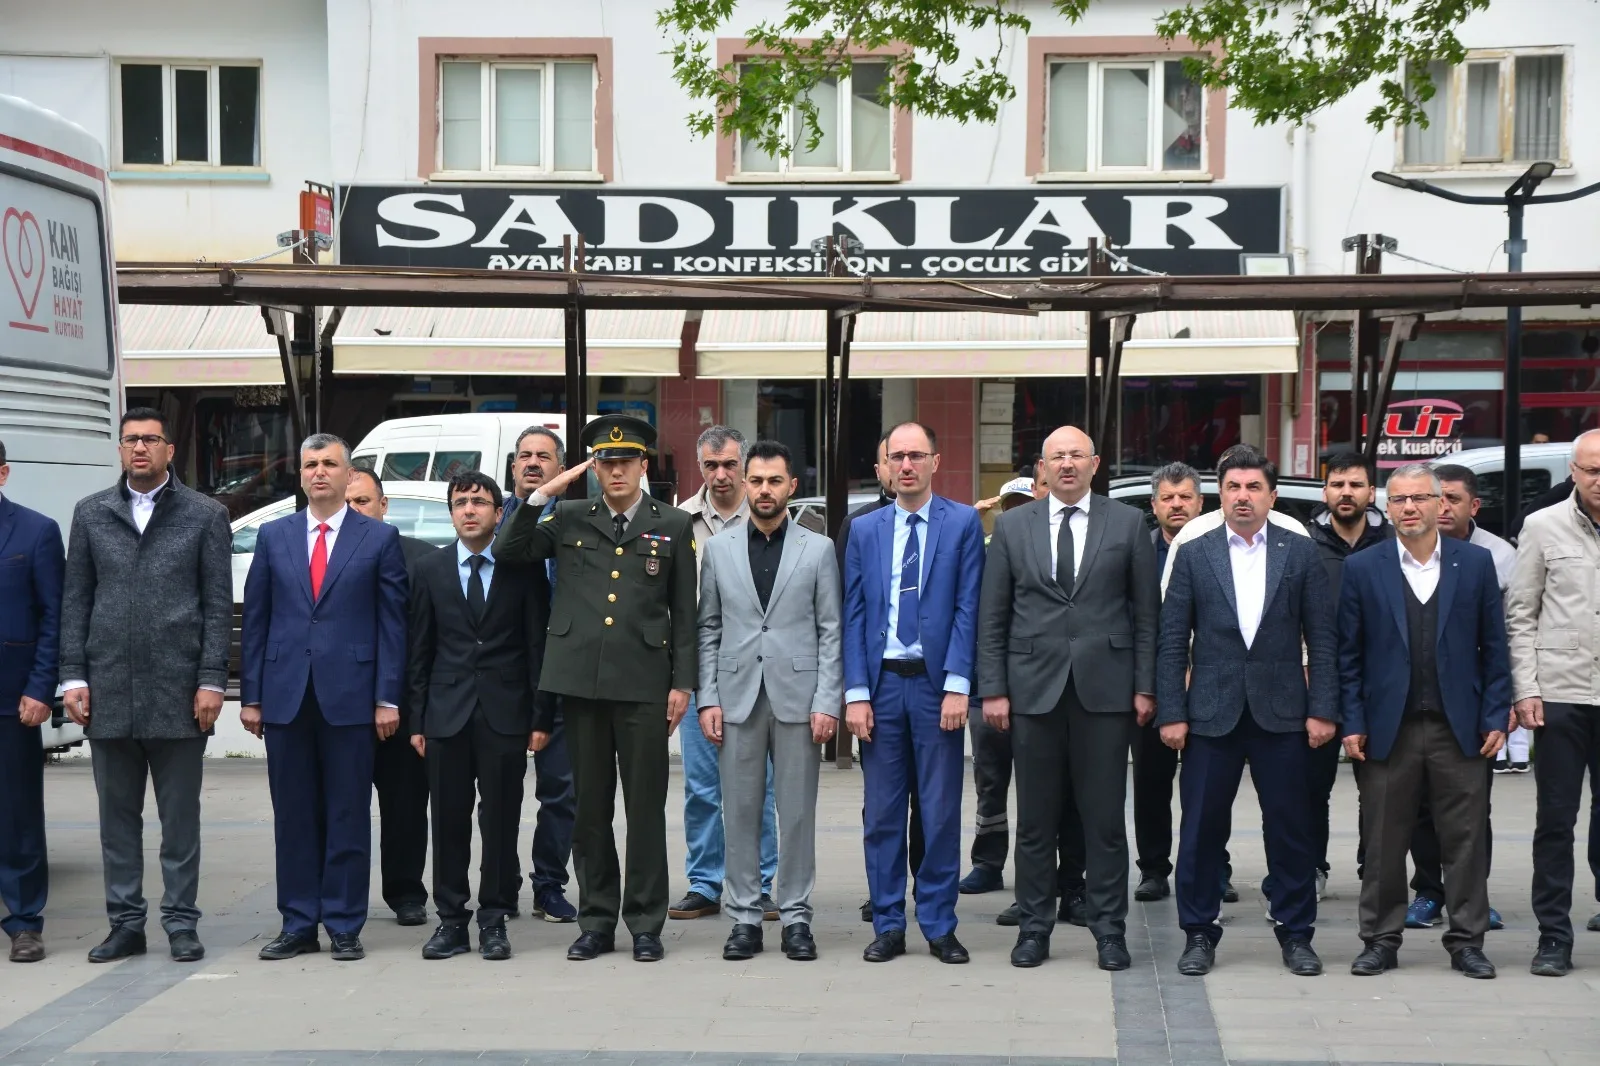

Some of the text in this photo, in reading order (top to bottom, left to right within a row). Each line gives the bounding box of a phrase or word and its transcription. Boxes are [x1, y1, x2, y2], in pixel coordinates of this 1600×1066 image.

[376, 193, 1243, 250] SADIKLAR
[47, 219, 80, 264] KAN
[673, 252, 891, 272] KONFEKSİON
[921, 256, 1031, 276] ÇOCUK
[1039, 252, 1130, 273] GİYM
[52, 264, 82, 298] BAĞIŞI
[53, 294, 83, 321] HAYAT
[54, 320, 84, 340] KURTARIR
[1361, 405, 1464, 437] LİT
